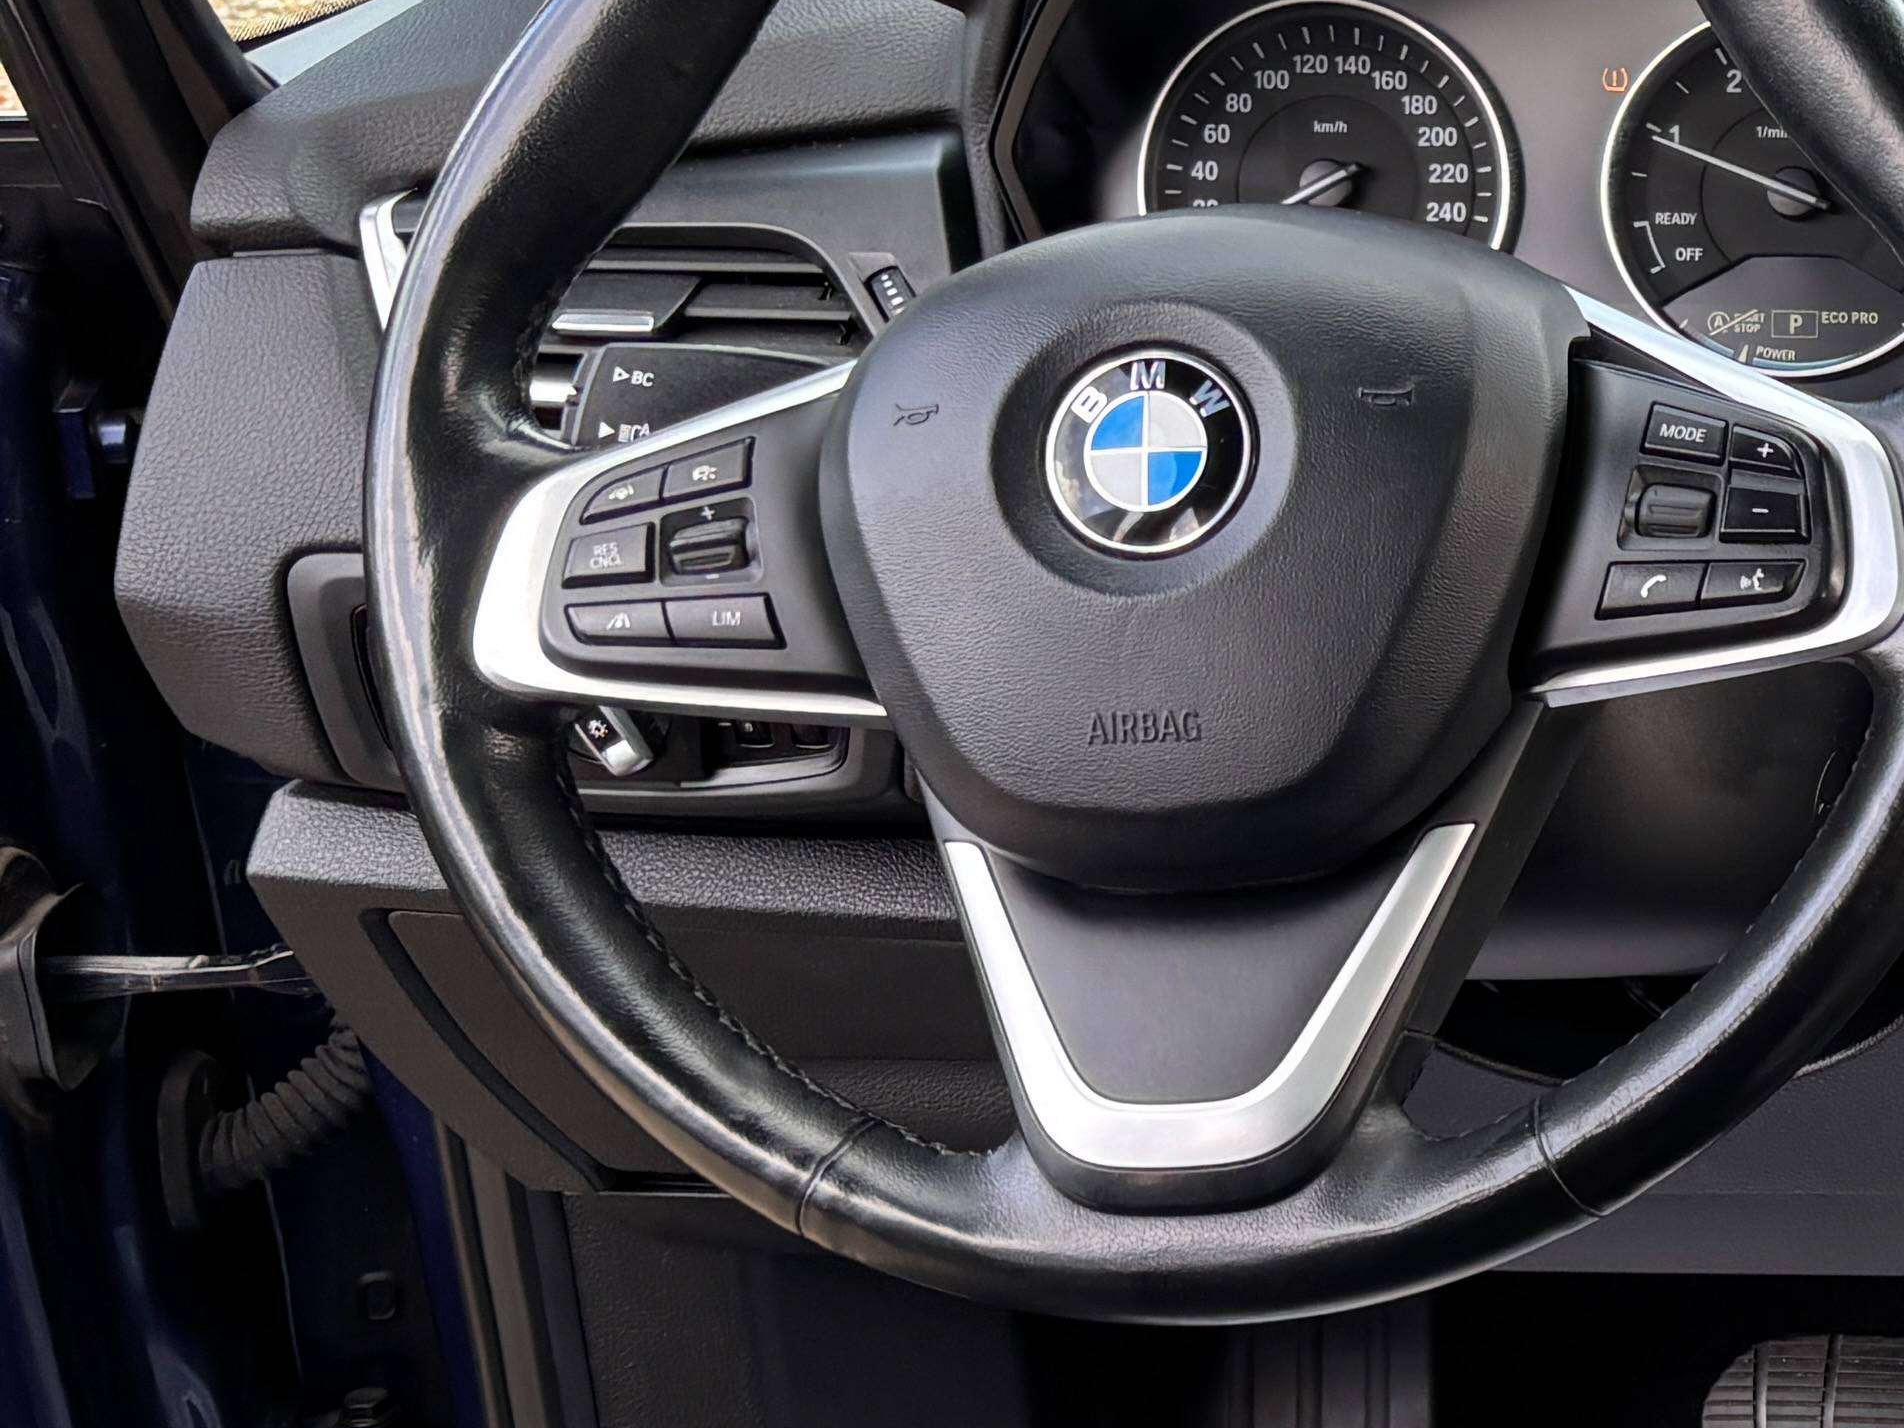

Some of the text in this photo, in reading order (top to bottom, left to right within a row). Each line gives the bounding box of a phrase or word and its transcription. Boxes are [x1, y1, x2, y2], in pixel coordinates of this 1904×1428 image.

[1293, 54, 1328, 75] 120
[1335, 55, 1371, 75] 140
[1254, 70, 1290, 90] 100
[1371, 71, 1408, 91] 160
[1726, 69, 1742, 94] 2
[1225, 93, 1252, 114] 80
[1402, 94, 1438, 115] 180
[1204, 123, 1231, 144] 60
[1312, 119, 1348, 134] km/h
[1668, 125, 1680, 144] 1
[1418, 126, 1458, 148] 200
[1191, 160, 1218, 181] 40
[1428, 163, 1469, 183] 220
[1426, 202, 1467, 223] 240
[1655, 212, 1697, 225] READY
[1675, 247, 1703, 261] OFF
[1789, 314, 1803, 335] P
[1821, 312, 1879, 325] ECO PRO
[1755, 345, 1796, 361] POWER
[631, 370, 655, 387] BC
[1071, 360, 1230, 423] BMW
[1659, 423, 1707, 443] MODE
[711, 611, 742, 627] LIM
[1088, 709, 1202, 746] AIRBAG
